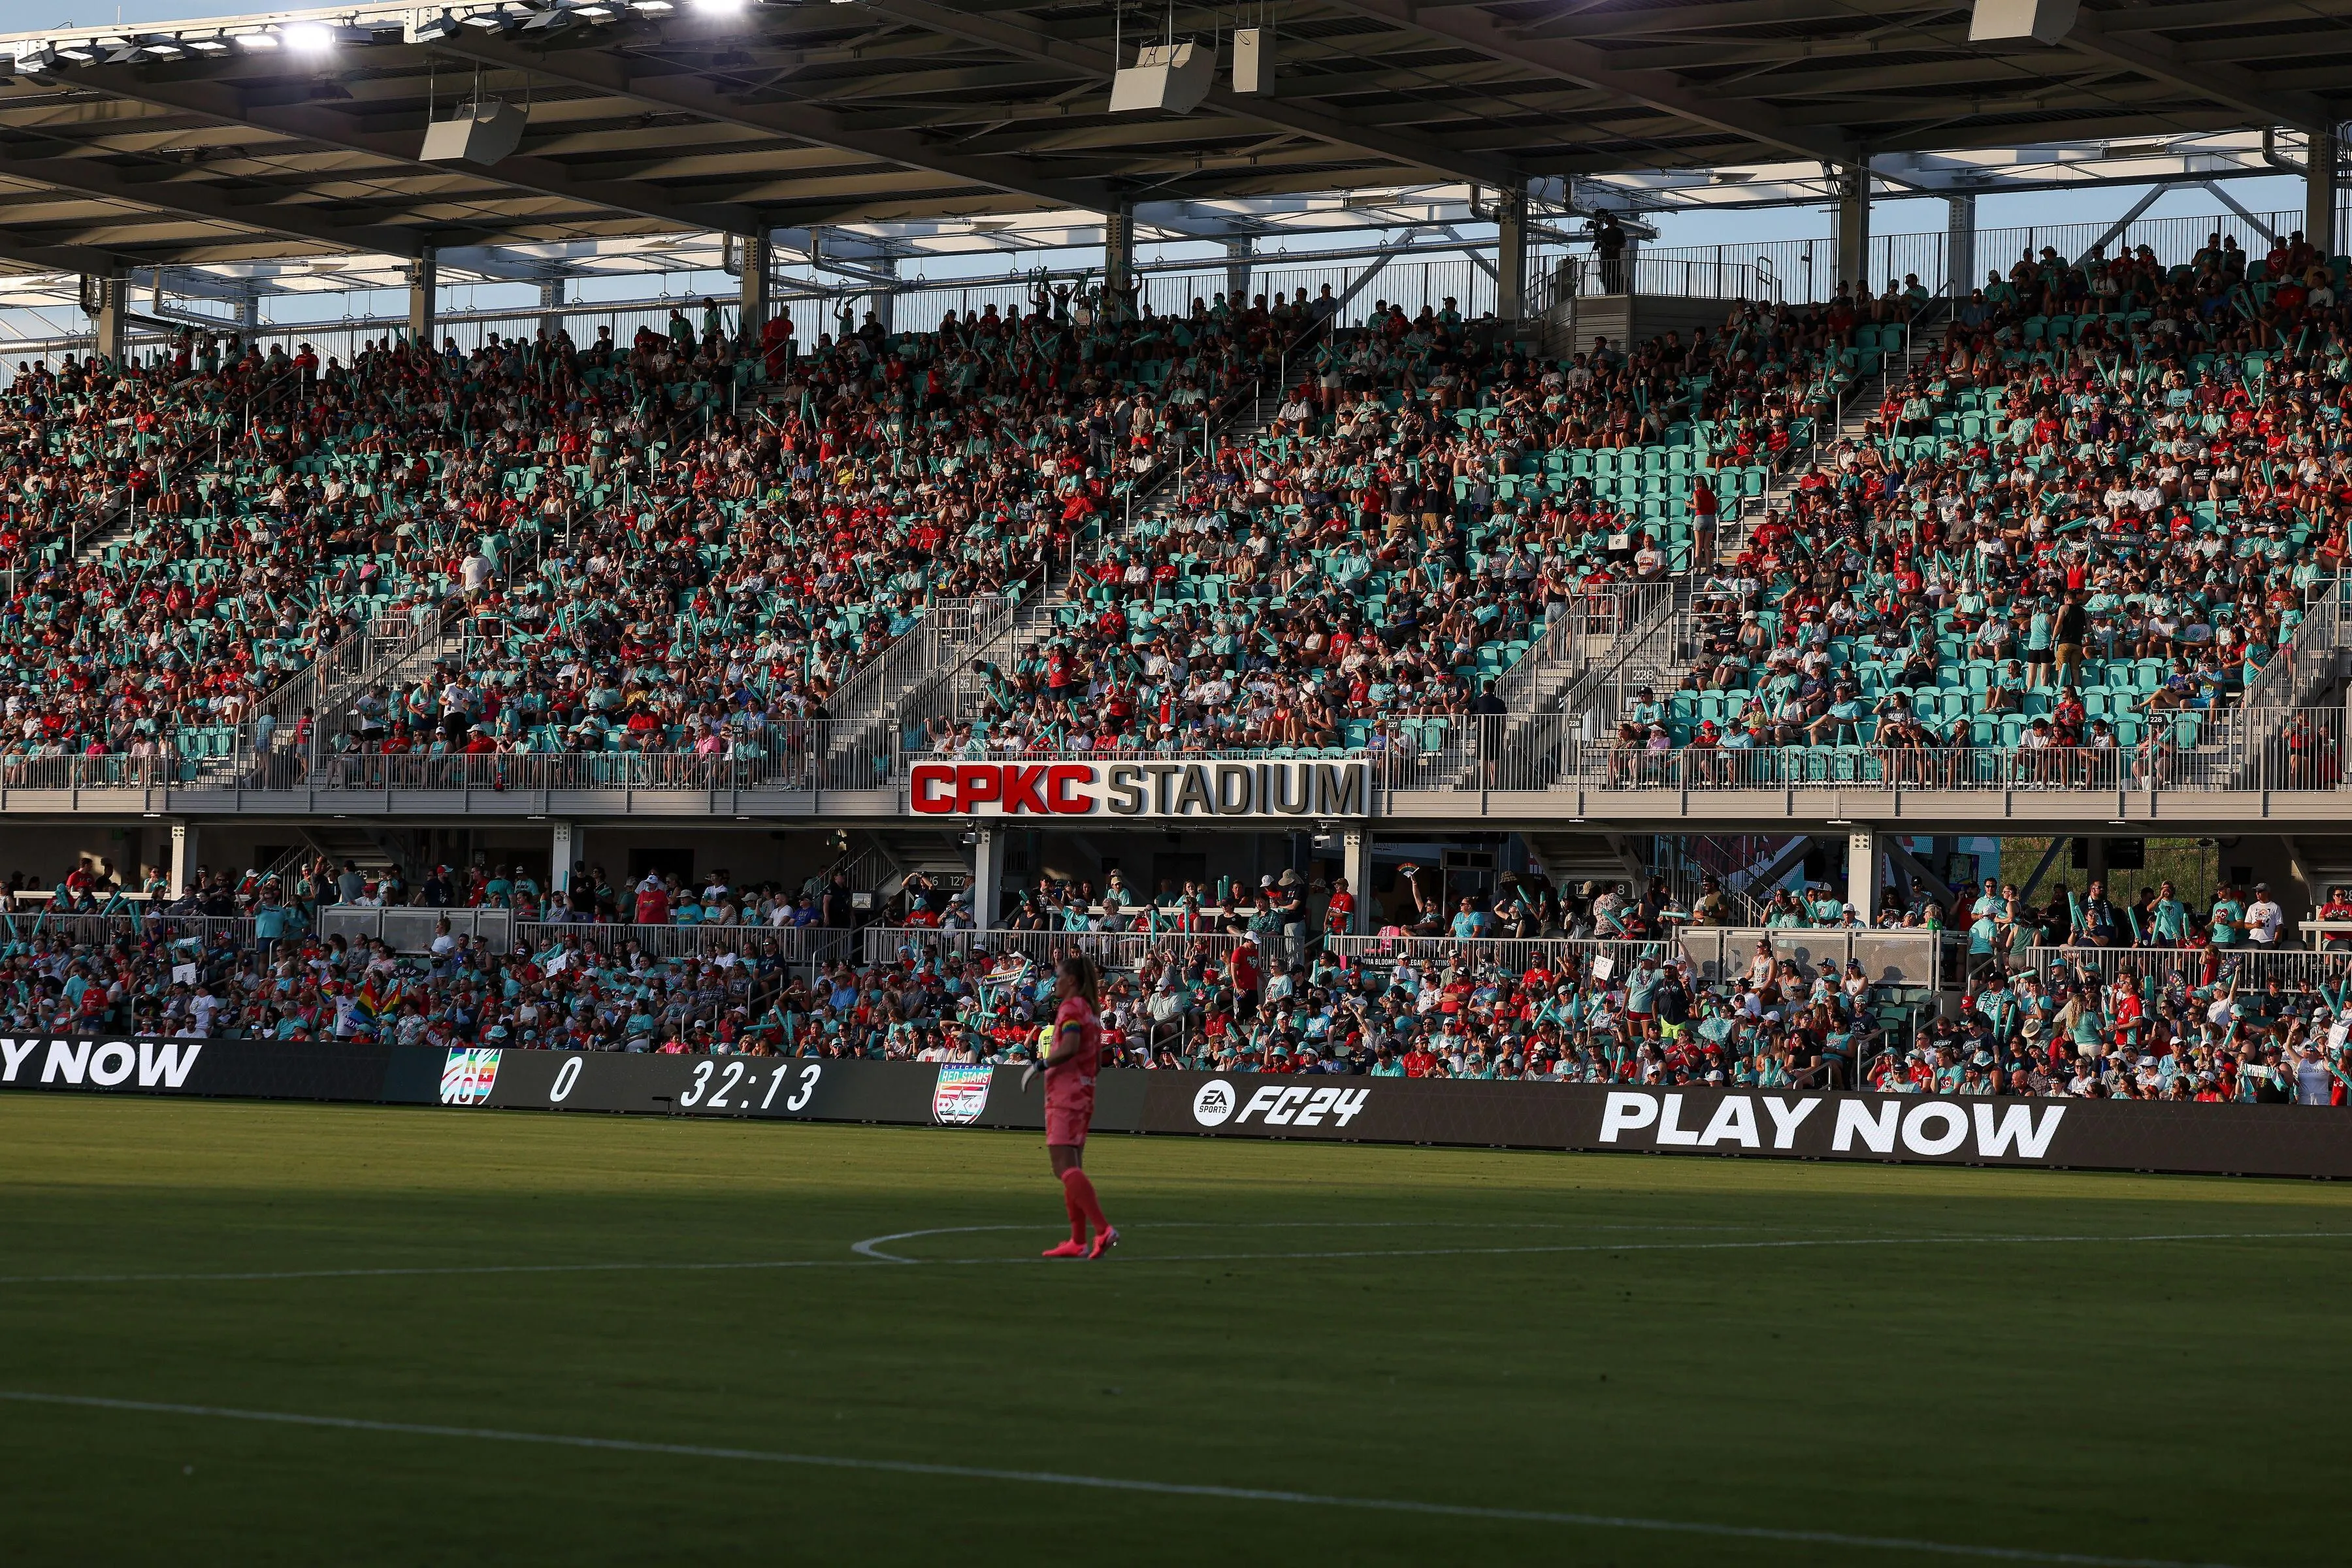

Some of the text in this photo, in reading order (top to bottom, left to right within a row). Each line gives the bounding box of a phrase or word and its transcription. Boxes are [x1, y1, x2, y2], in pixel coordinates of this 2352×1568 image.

[912, 764, 1364, 815] CPKC STADIUM
[950, 876, 966, 887] 127
[997, 971, 1021, 982] CURRE
[41, 1041, 202, 1088] NOW
[550, 1056, 582, 1102] 0
[942, 1070, 989, 1083] RED STARS
[681, 1061, 821, 1111] 32:13
[1201, 1090, 1228, 1105] EA
[1235, 1086, 1371, 1127] FC24
[1199, 1105, 1227, 1114] SPORTS
[1599, 1092, 2066, 1158] PLAY NOW
